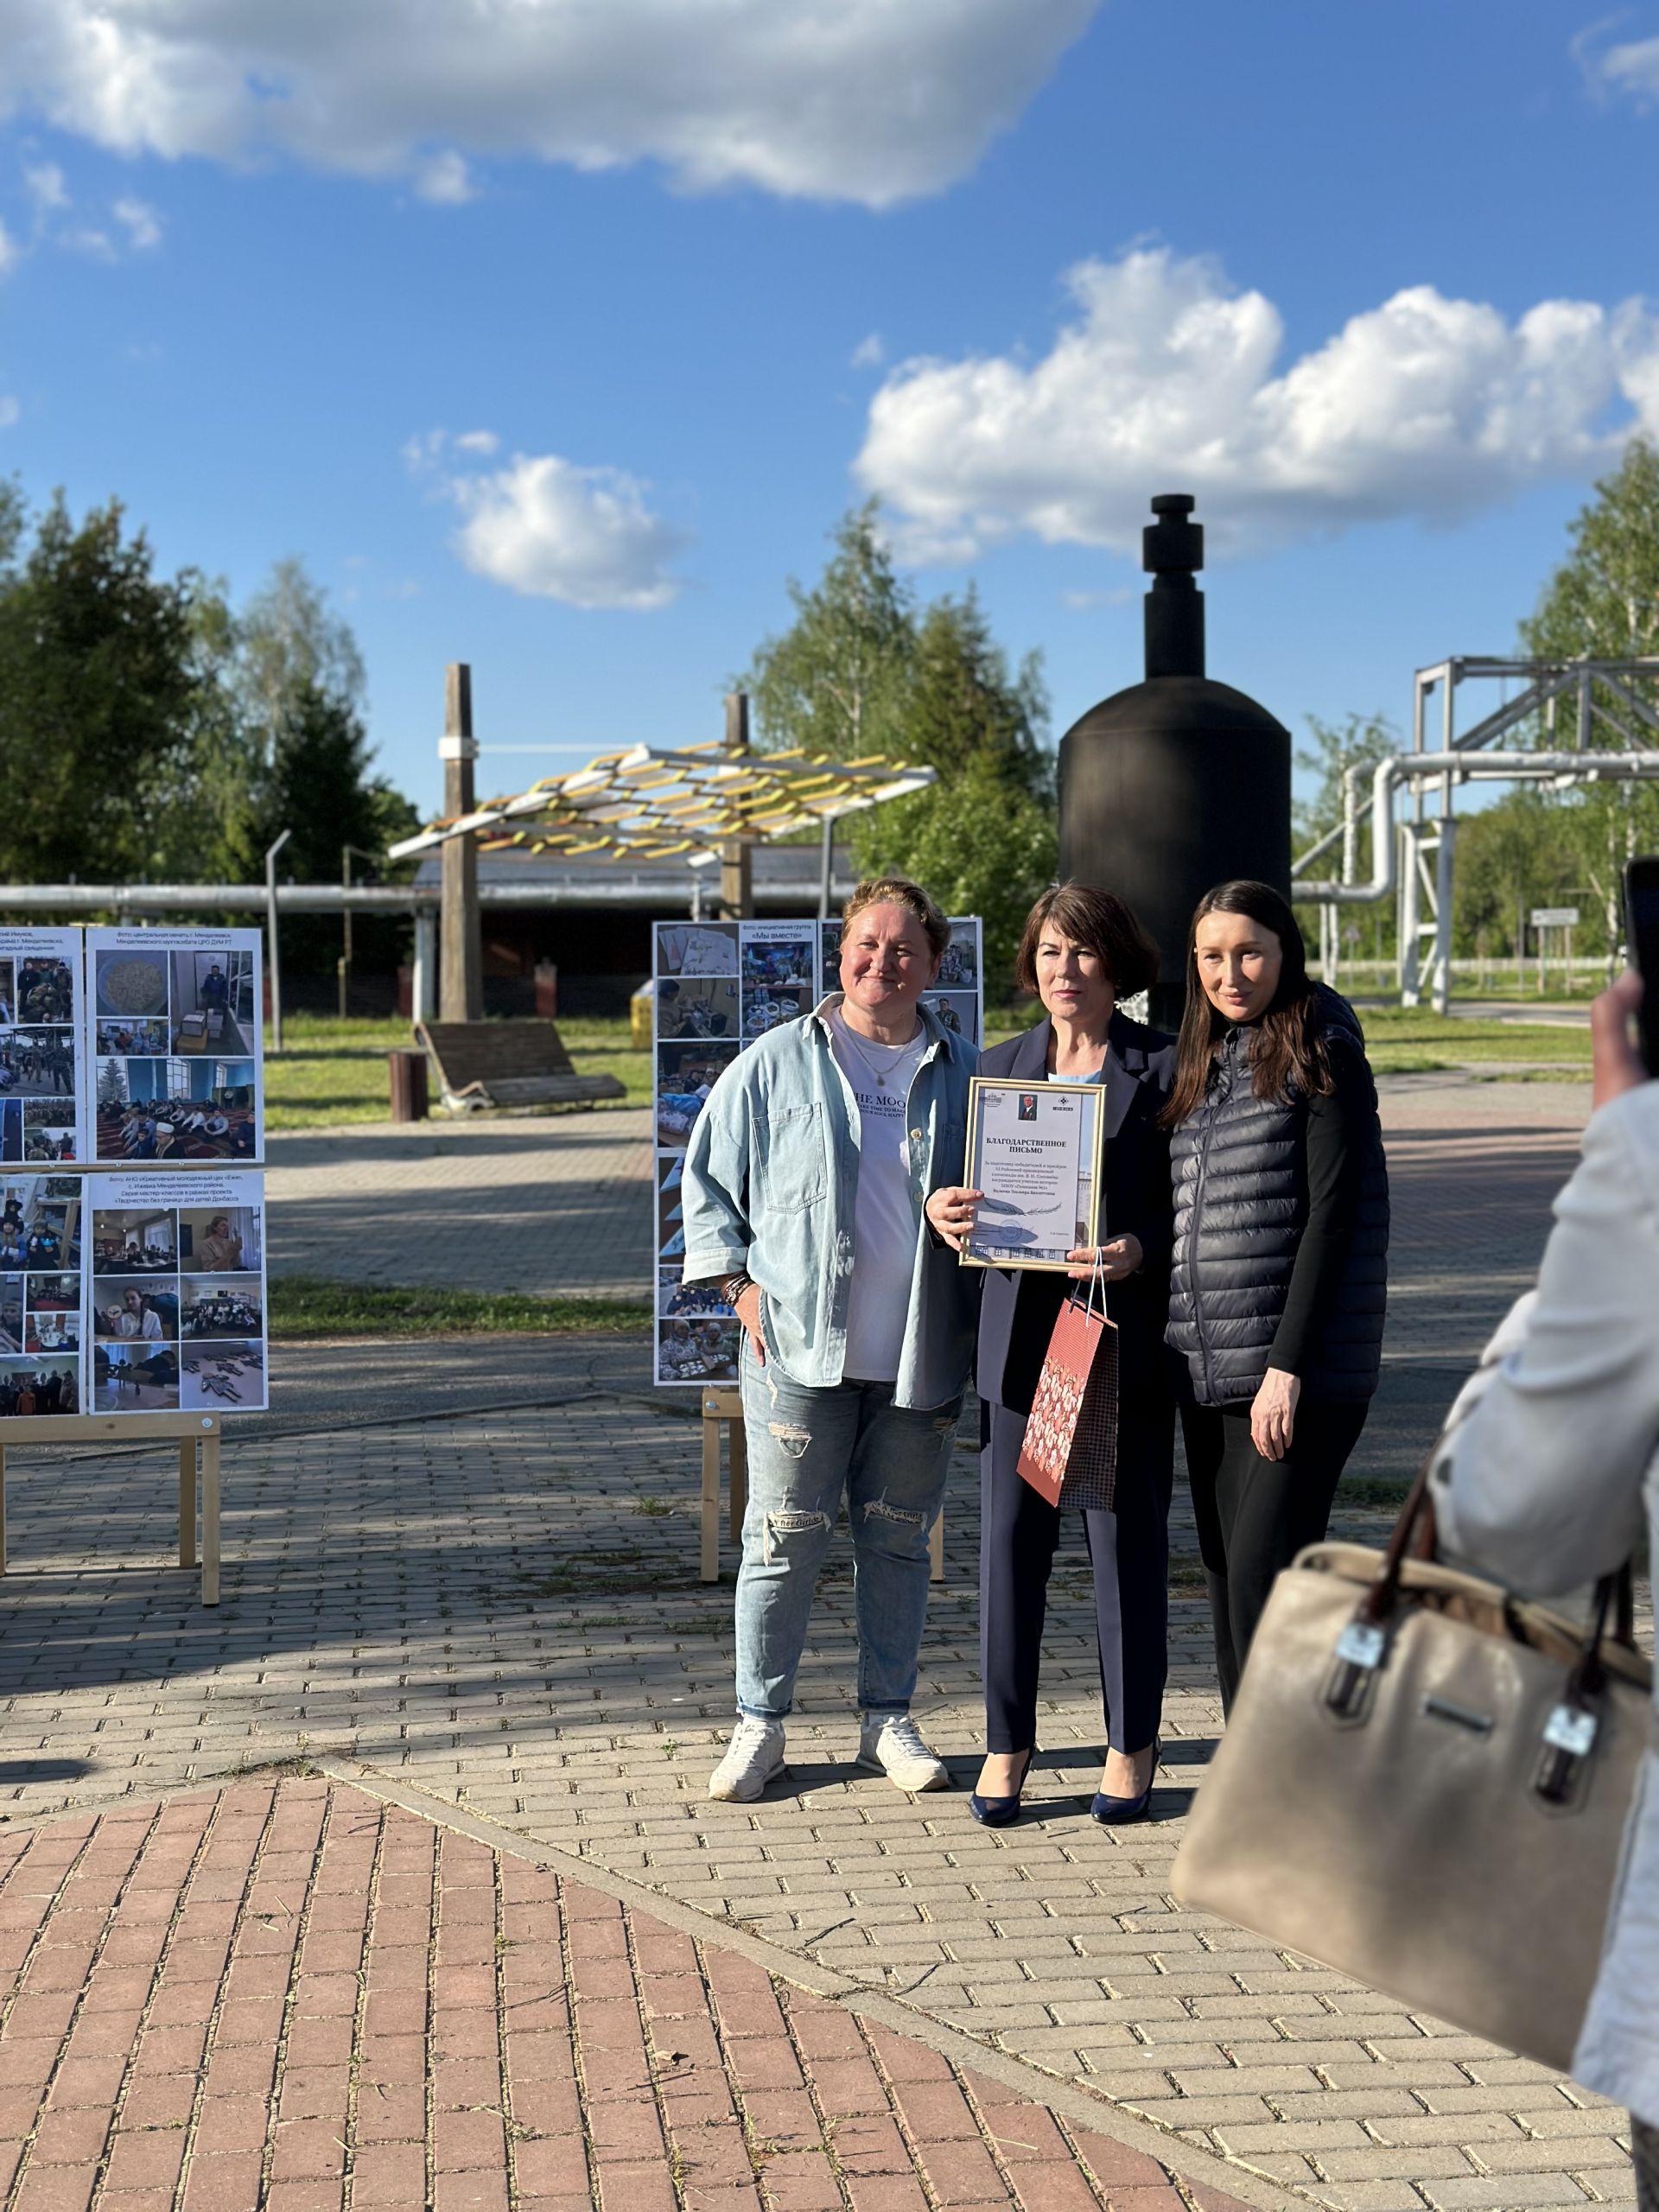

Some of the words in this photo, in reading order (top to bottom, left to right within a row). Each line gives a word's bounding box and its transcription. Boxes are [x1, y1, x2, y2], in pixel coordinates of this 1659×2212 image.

[855, 1092, 873, 1104] HE
[986, 1138, 1066, 1147] БЛАГОДАРСТВЕННОЕ
[1009, 1146, 1043, 1154] ПИСЬМО
